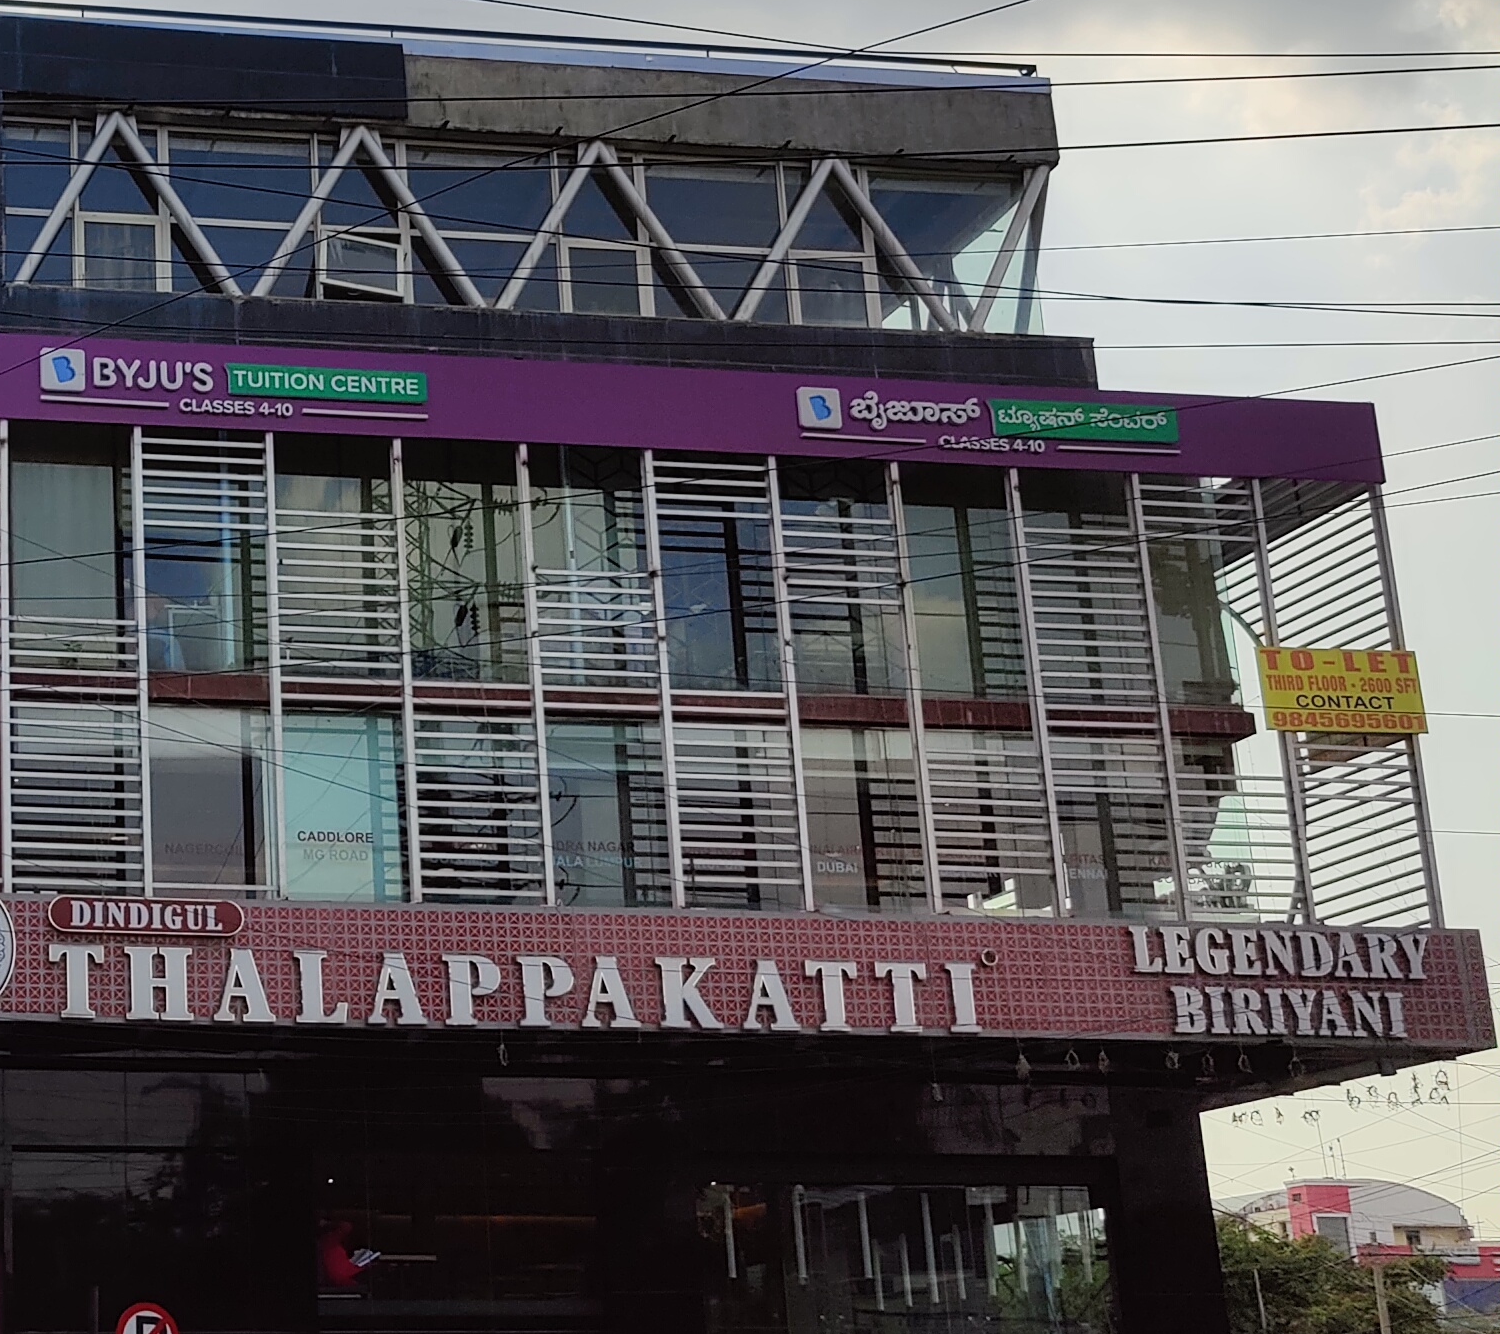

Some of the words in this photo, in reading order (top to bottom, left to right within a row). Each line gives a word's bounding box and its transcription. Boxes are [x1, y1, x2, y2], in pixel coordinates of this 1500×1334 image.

[93, 357, 214, 392] BYJU'S
[233, 370, 325, 391] TUITION
[331, 375, 420, 396] CENTRE
[179, 398, 255, 416] CLASSES
[259, 402, 293, 417] 4-10
[938, 435, 1010, 452] CLASSES
[1012, 438, 1045, 453] 4-10
[1266, 674, 1304, 692] THIRD
[1308, 675, 1347, 692] FLOOR
[1360, 677, 1392, 694] 2600
[1395, 678, 1417, 695] SFT
[1296, 694, 1394, 710] CONTACT
[1273, 712, 1425, 730] 9845695601
[297, 830, 374, 843] CADDLORE
[303, 849, 325, 861] MG
[329, 849, 368, 861] ROAD
[817, 861, 858, 874] DUBAI
[70, 901, 223, 932] DINDIGUL
[1128, 924, 1429, 980] LEGENDARY
[49, 943, 982, 1034] THALAPPAKATTI
[1170, 985, 1408, 1039] BIRIYANI
